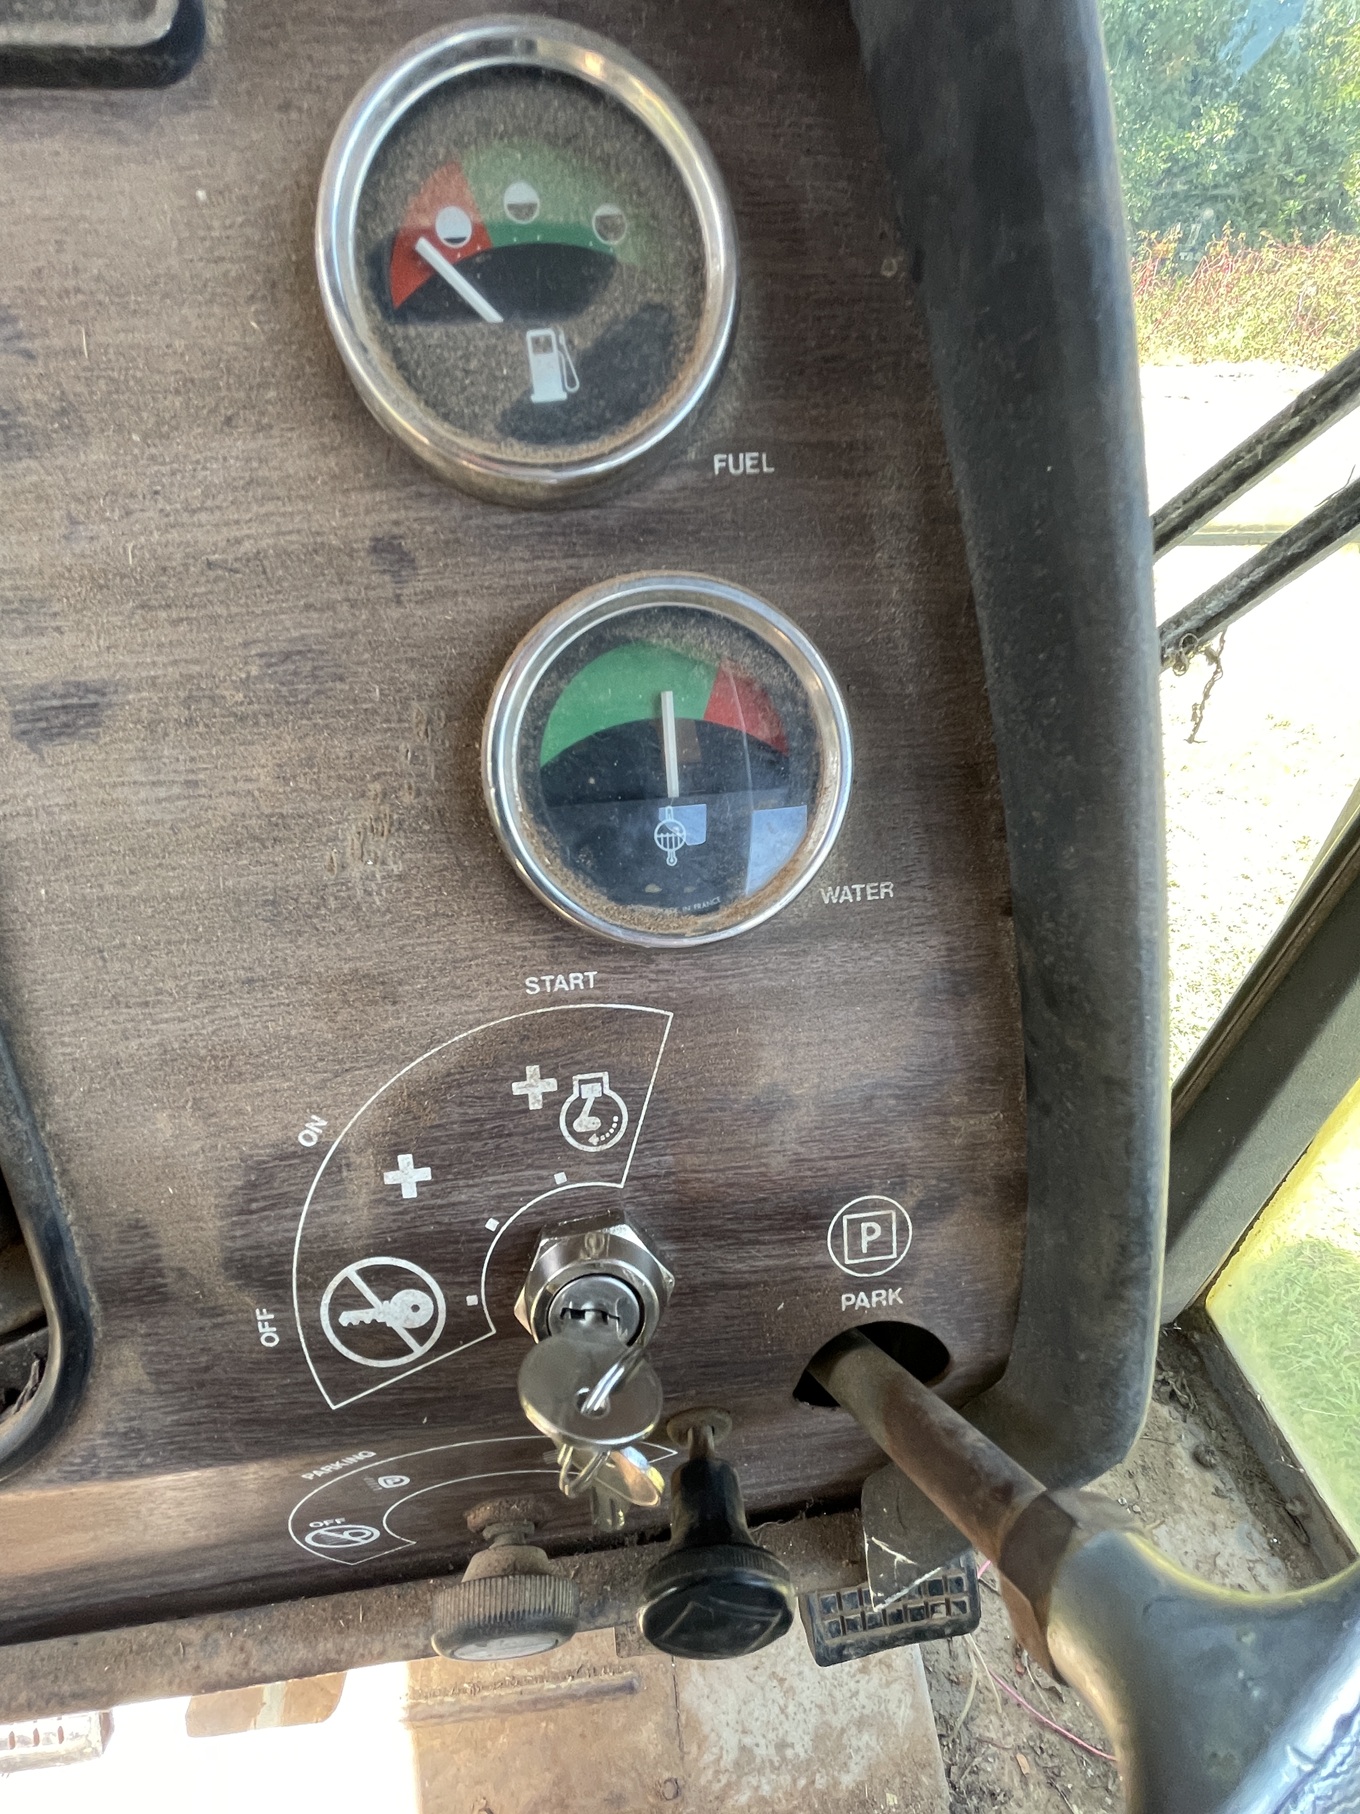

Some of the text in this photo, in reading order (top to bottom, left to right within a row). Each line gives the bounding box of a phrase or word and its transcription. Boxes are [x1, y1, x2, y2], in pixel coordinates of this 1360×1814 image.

[714, 452, 775, 476] FUEL
[693, 896, 721, 910] FRANCE
[820, 882, 894, 904] WATER
[525, 971, 598, 994] START
[298, 1115, 328, 1147] ON
[861, 1222, 881, 1253] P
[841, 1288, 903, 1311] PARK
[256, 1308, 279, 1347] OFF
[301, 1451, 376, 1480] PARKING
[309, 1518, 345, 1527] OFF
